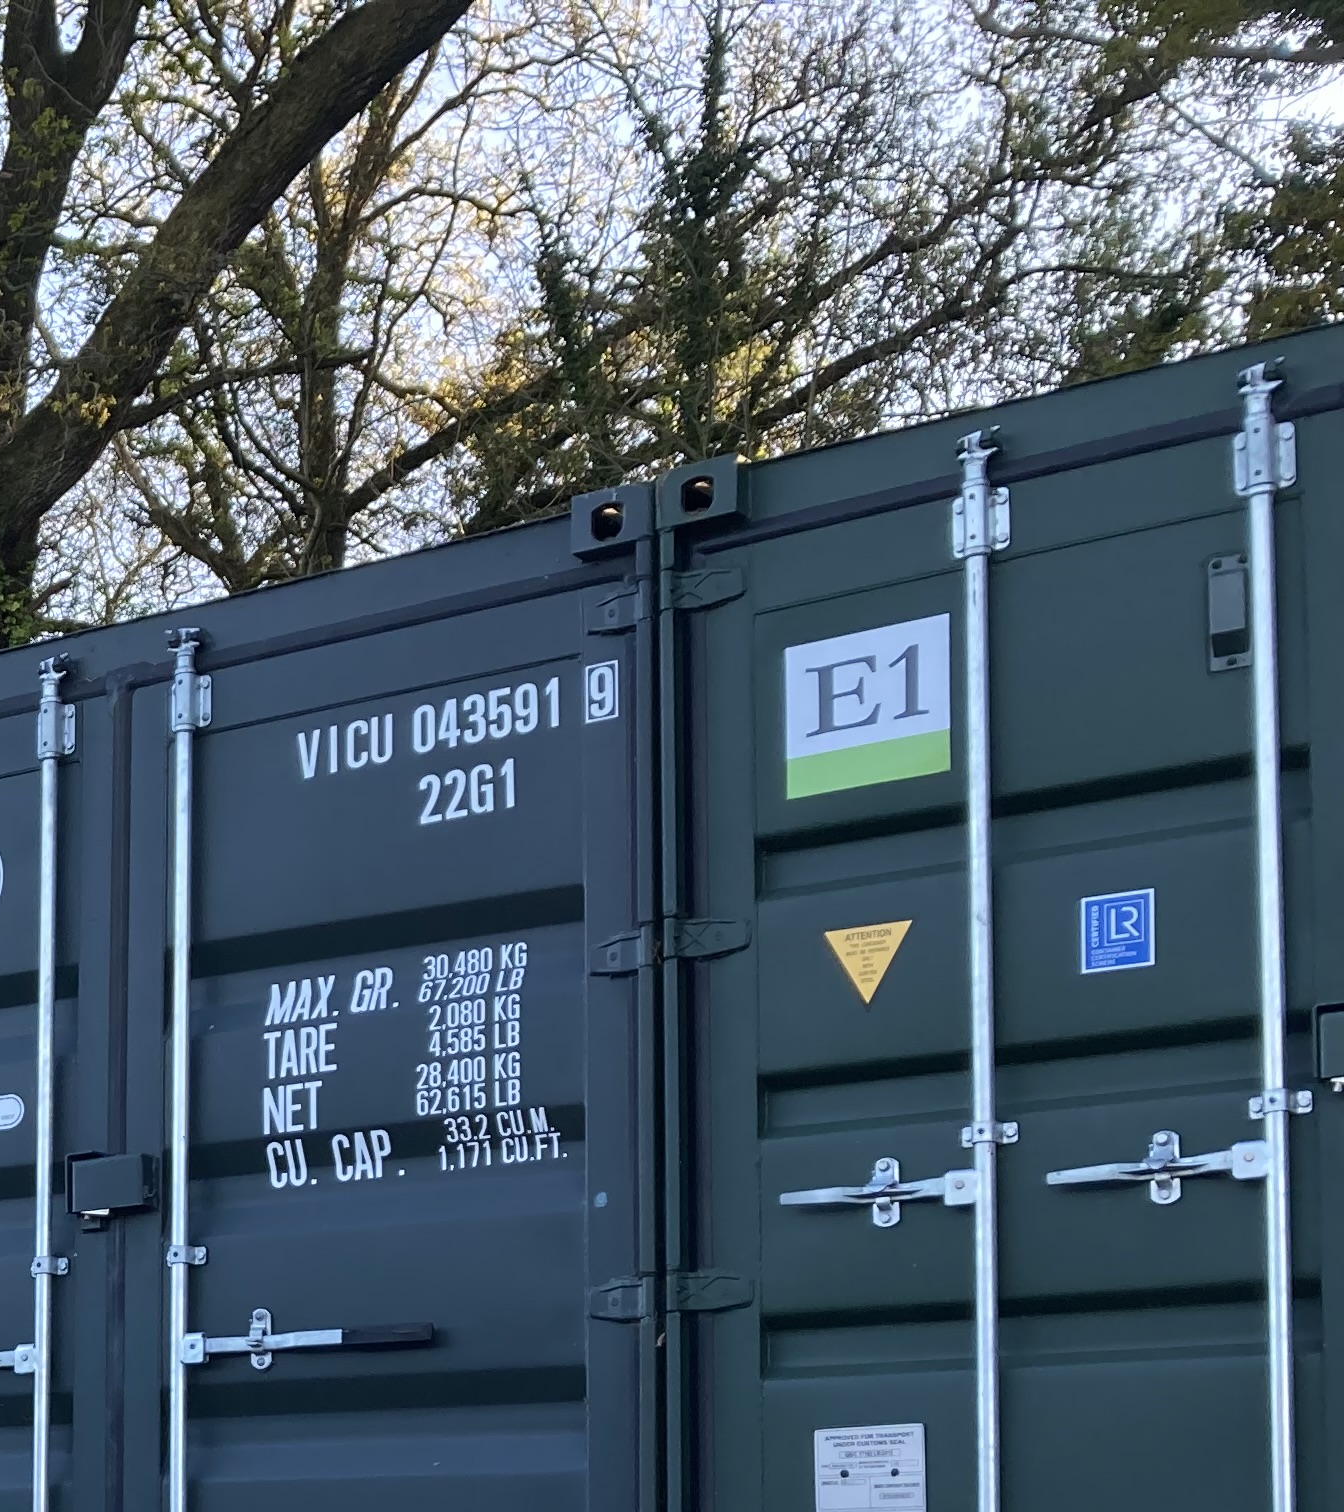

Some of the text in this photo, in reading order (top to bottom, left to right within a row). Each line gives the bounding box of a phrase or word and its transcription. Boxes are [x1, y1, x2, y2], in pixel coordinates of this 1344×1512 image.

[804, 642, 929, 738] E1
[296, 664, 615, 779] VICU 043591 9
[419, 758, 516, 825] 22G1
[845, 928, 892, 942] ATTENTION
[1110, 906, 1140, 940] LR
[499, 941, 528, 970] KG
[264, 966, 400, 1026] MAX. GR.
[495, 968, 525, 993] LB
[494, 993, 521, 1022] KG
[264, 1022, 338, 1080] TARE
[494, 1020, 520, 1049] LB
[494, 1051, 521, 1080] KG
[263, 1080, 323, 1135] NET
[494, 1079, 521, 1108] LB
[443, 1106, 555, 1143] 33.2 CU.M.
[265, 1138, 317, 1189] CU.
[501, 1133, 568, 1164] CU.FT.
